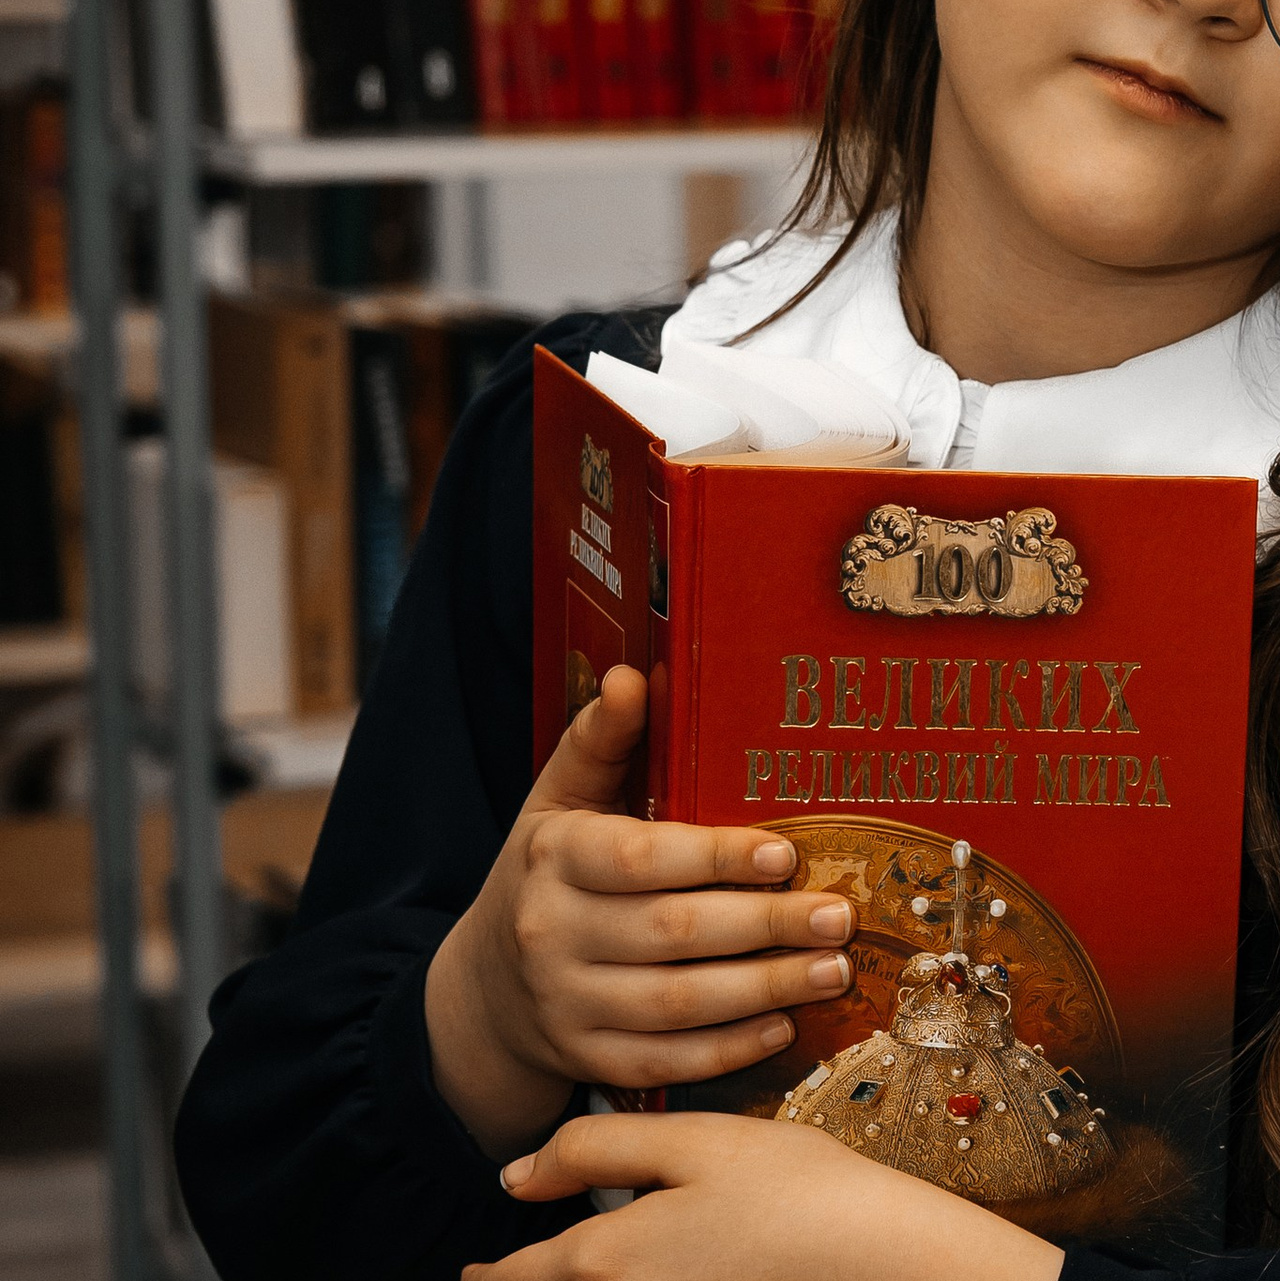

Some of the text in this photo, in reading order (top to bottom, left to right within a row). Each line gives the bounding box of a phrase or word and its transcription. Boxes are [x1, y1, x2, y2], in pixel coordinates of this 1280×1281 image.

[912, 544, 1013, 604] 100
[779, 654, 1141, 734] ВЕЛИКИХ
[743, 739, 1172, 808] РЕЛИКВИЙ МИРА
